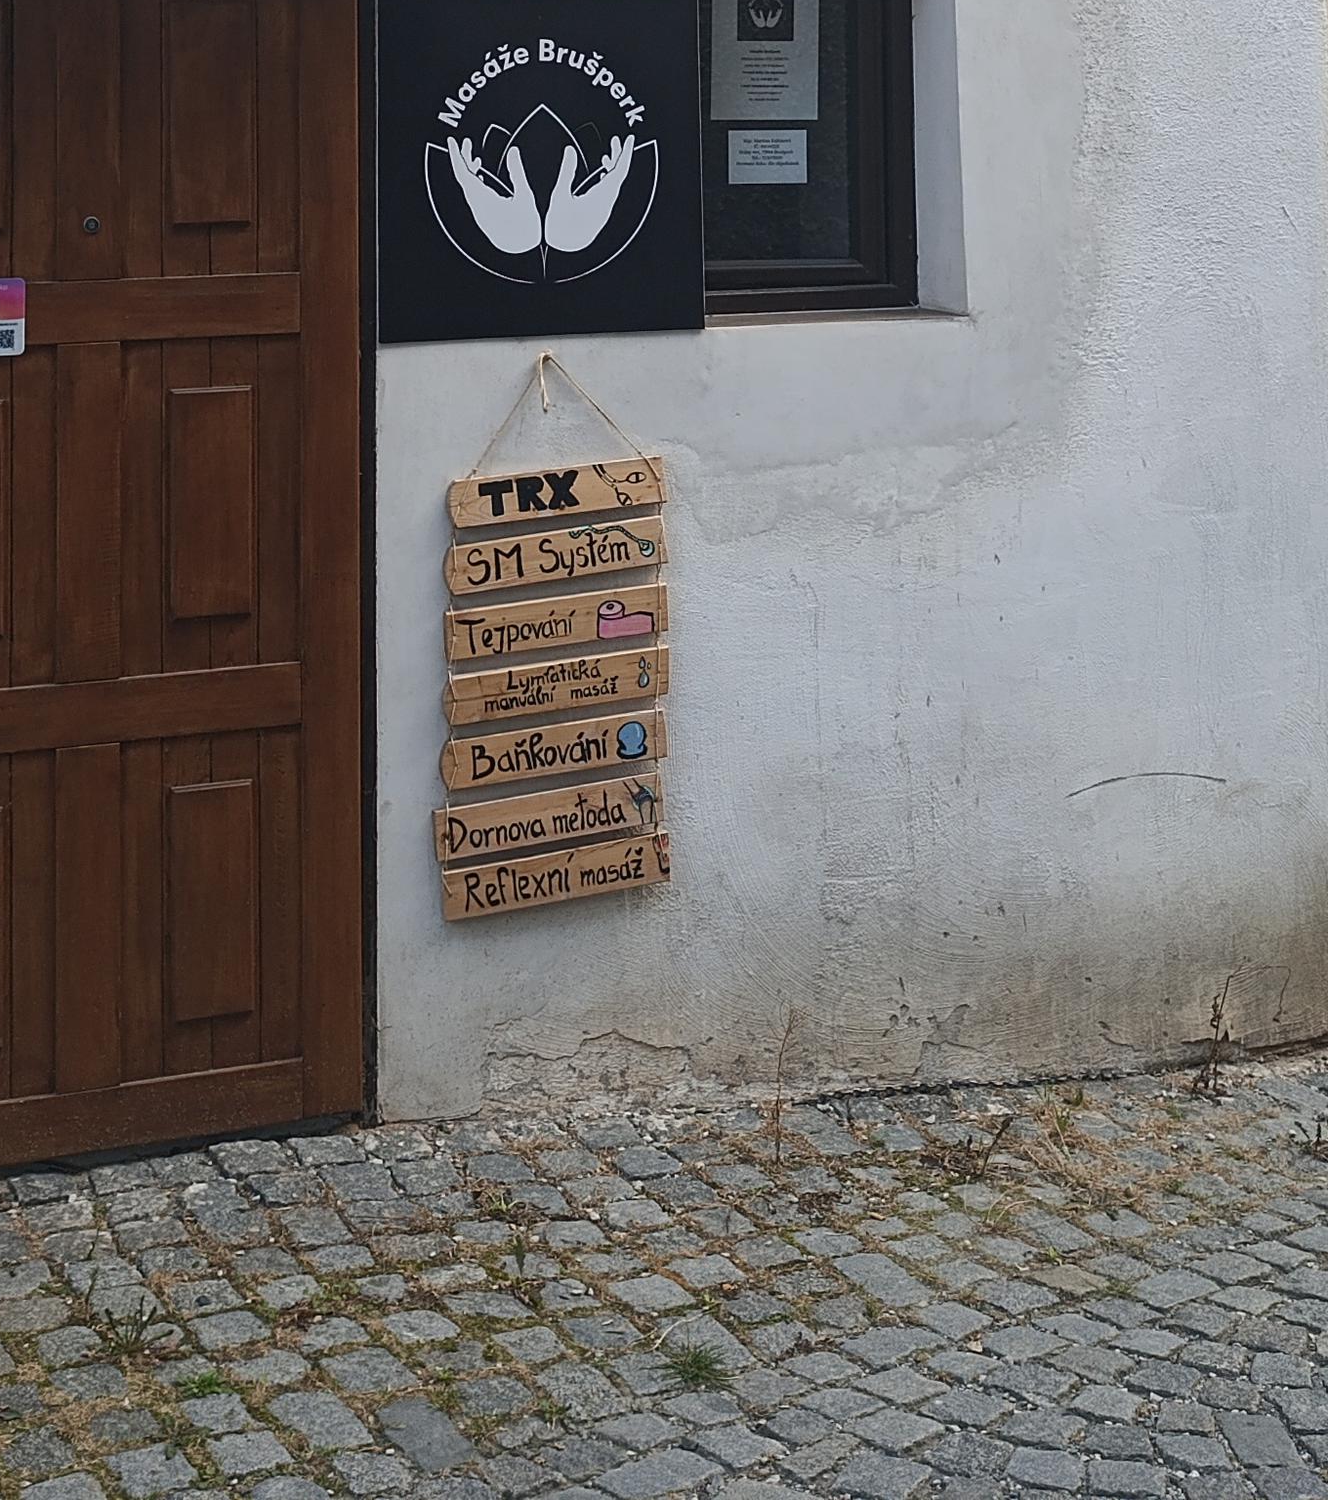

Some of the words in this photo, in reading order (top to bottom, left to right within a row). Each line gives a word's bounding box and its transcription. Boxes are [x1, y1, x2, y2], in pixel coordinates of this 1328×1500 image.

[437, 43, 530, 128] Masáže
[538, 38, 647, 128] Brušperk
[478, 469, 580, 517] TRX
[467, 543, 525, 585] SM
[539, 532, 631, 577] Systém
[456, 609, 576, 654] Tejpování
[484, 685, 556, 713] manuální
[570, 675, 619, 699] masáž
[507, 659, 601, 694] Lymfatická
[471, 729, 609, 781] Baňkování
[448, 816, 546, 853] Dornova
[552, 790, 627, 835] metoda
[464, 853, 574, 913] Reflexní
[580, 847, 645, 887] masáž
